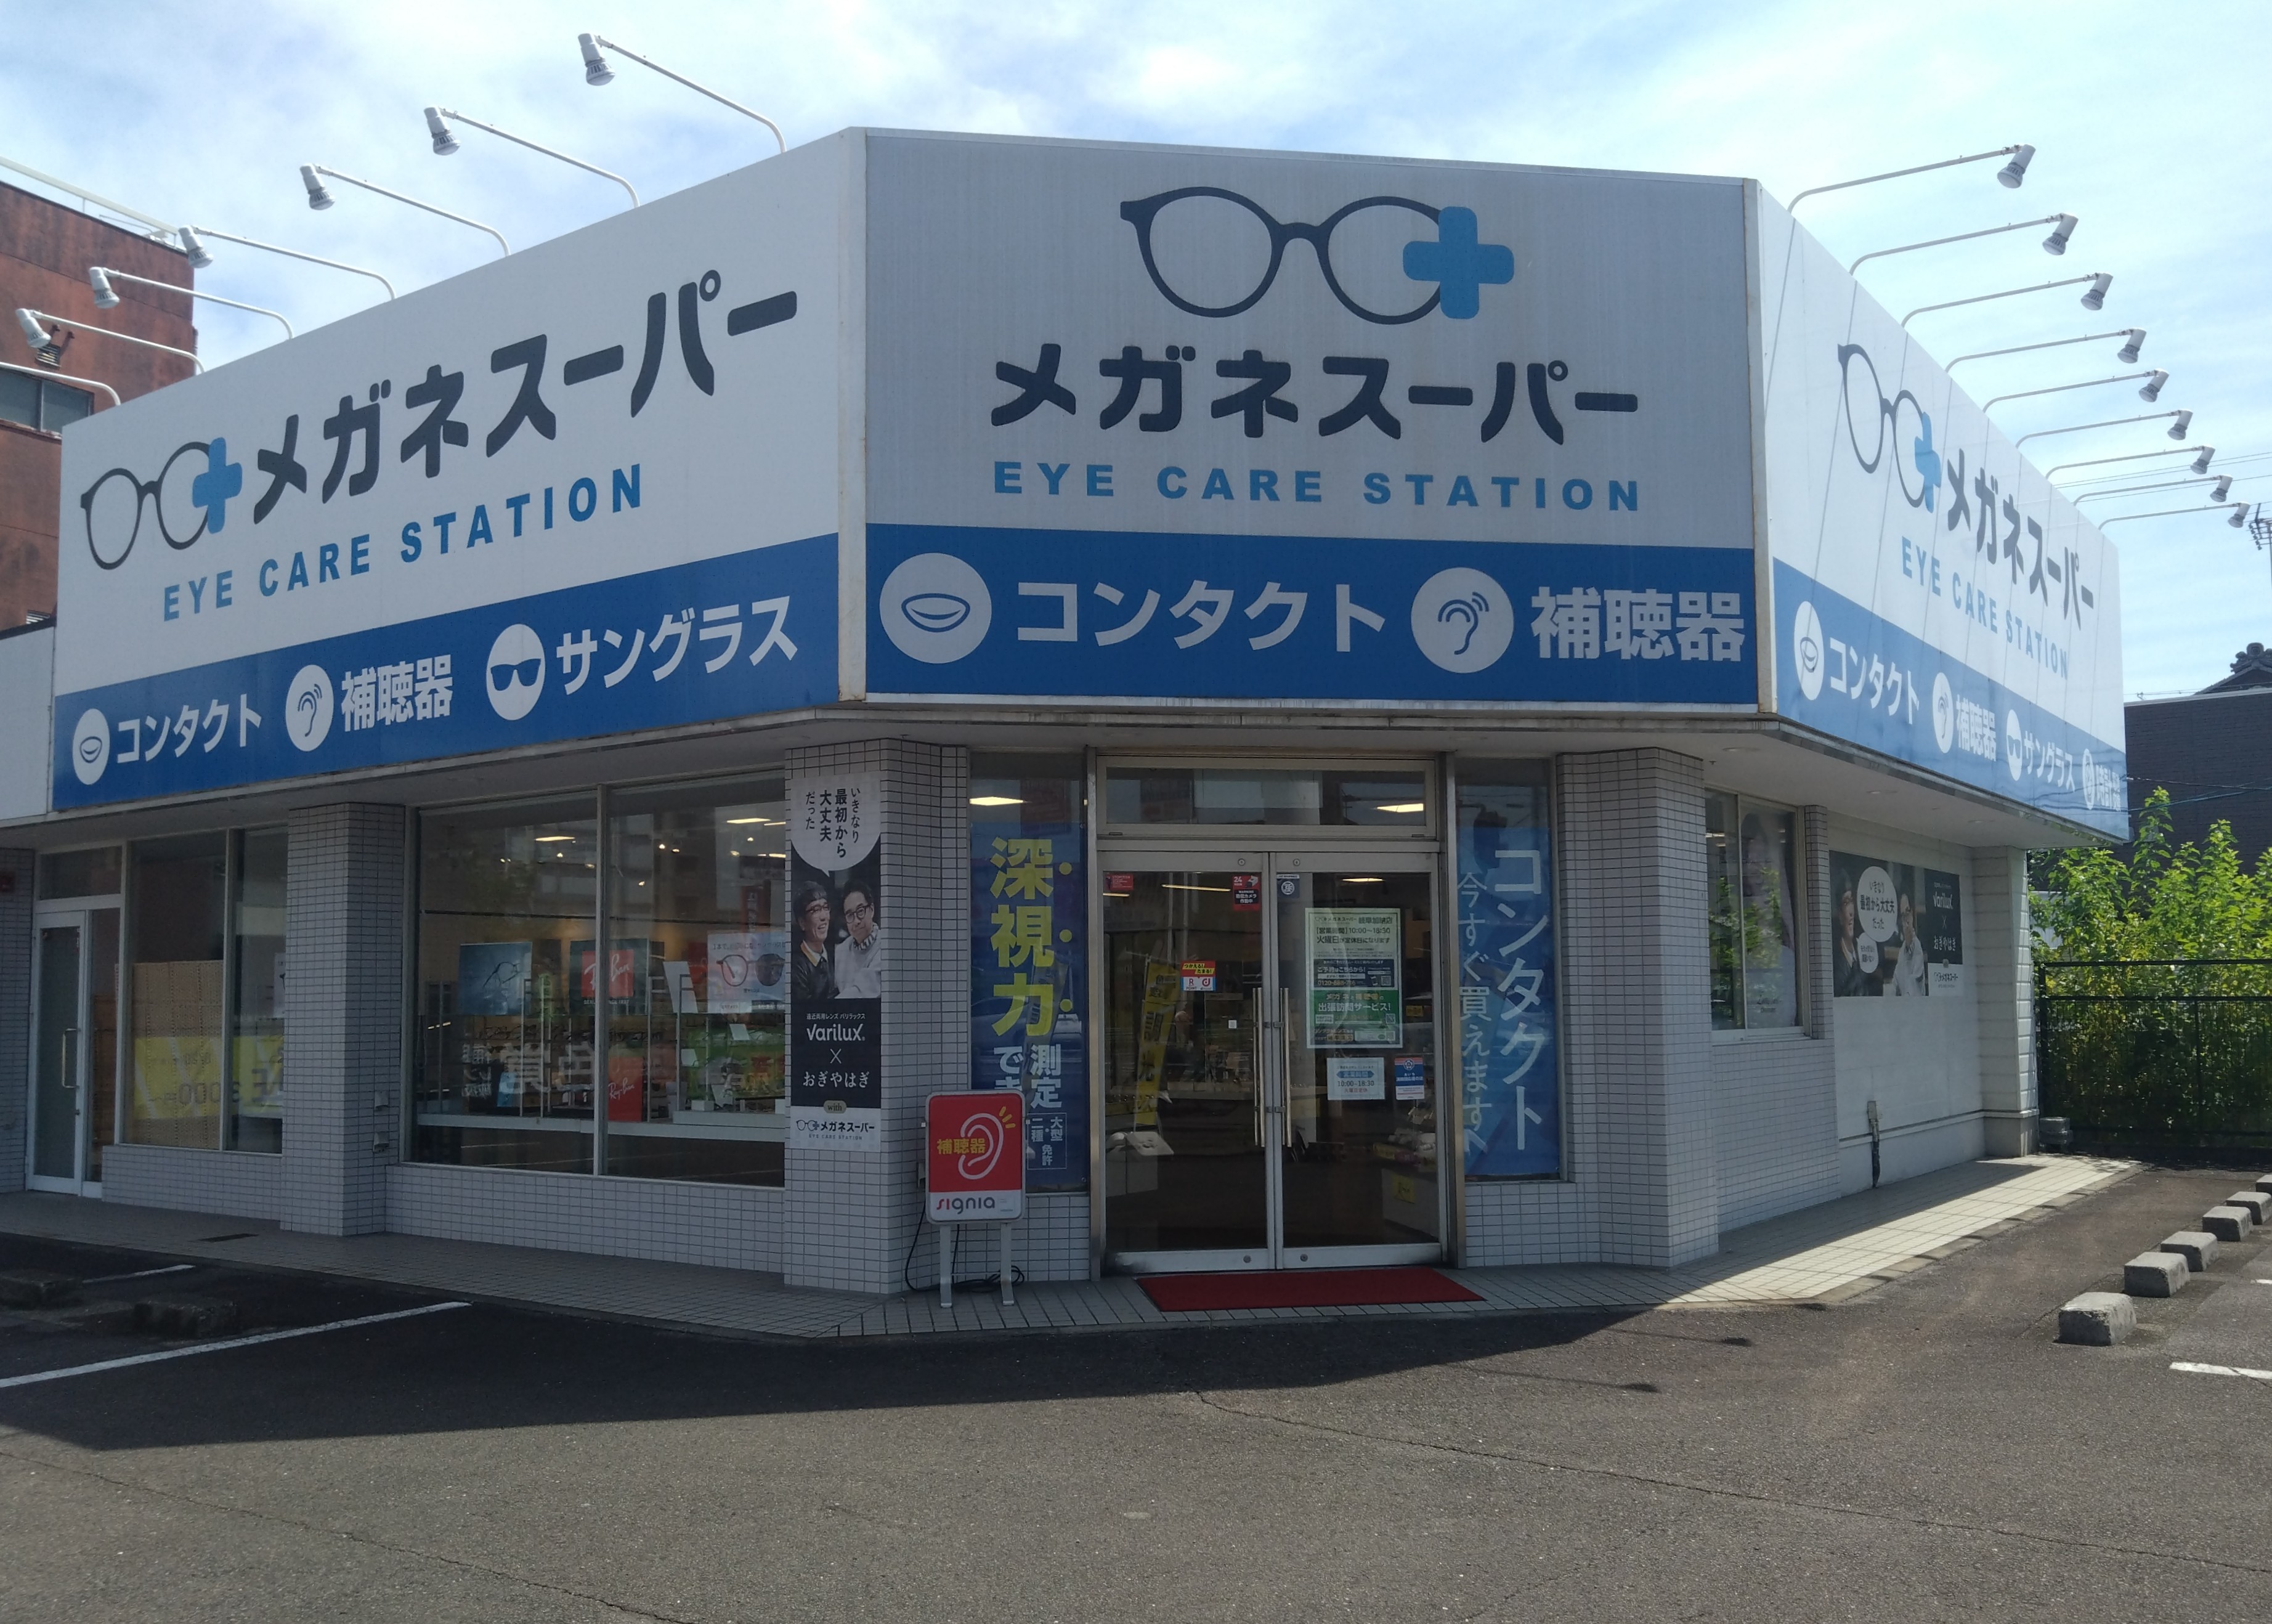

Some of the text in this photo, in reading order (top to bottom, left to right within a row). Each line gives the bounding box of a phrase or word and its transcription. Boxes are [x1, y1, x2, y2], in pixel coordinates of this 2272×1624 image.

[254, 270, 797, 524] メガネスーパー
[991, 343, 1638, 445] メガネスーパー
[994, 461, 1639, 511] EYE CARE STATION
[164, 463, 641, 622] EYE CARE STATION
[1947, 448, 2094, 630] メガネスーパー
[1016, 579, 1746, 662] コンタクト 補聴器
[1902, 536, 2069, 680] EYE CARE STATION
[117, 596, 798, 764] コンタクト 補聴器 サングラス
[1830, 637, 1919, 725] コンタクト
[1955, 694, 1997, 761] 補聴器
[2024, 731, 2075, 792] サングラス
[806, 791, 815, 830] だった
[820, 790, 832, 842] 大丈夫
[835, 789, 848, 858] 最初から
[851, 788, 861, 843] いきなり
[1860, 895, 1895, 914] 最初から大丈夫
[989, 837, 1055, 1037] 深視力
[1934, 935, 1956, 951] おぎやはぎ
[1456, 872, 1492, 1132] 今すぐ買えます
[1495, 850, 1548, 1151] コンタクト
[803, 1071, 869, 1088] おぎやはぎ
[1030, 1044, 1062, 1109] 測定
[821, 1121, 875, 1132] メガネスーパー
[827, 1103, 842, 1111] with
[1050, 1116, 1063, 1141] 大型
[936, 1138, 986, 1155] 補聴器
[1042, 1144, 1053, 1166] 免許
[936, 1196, 995, 1214] signia
